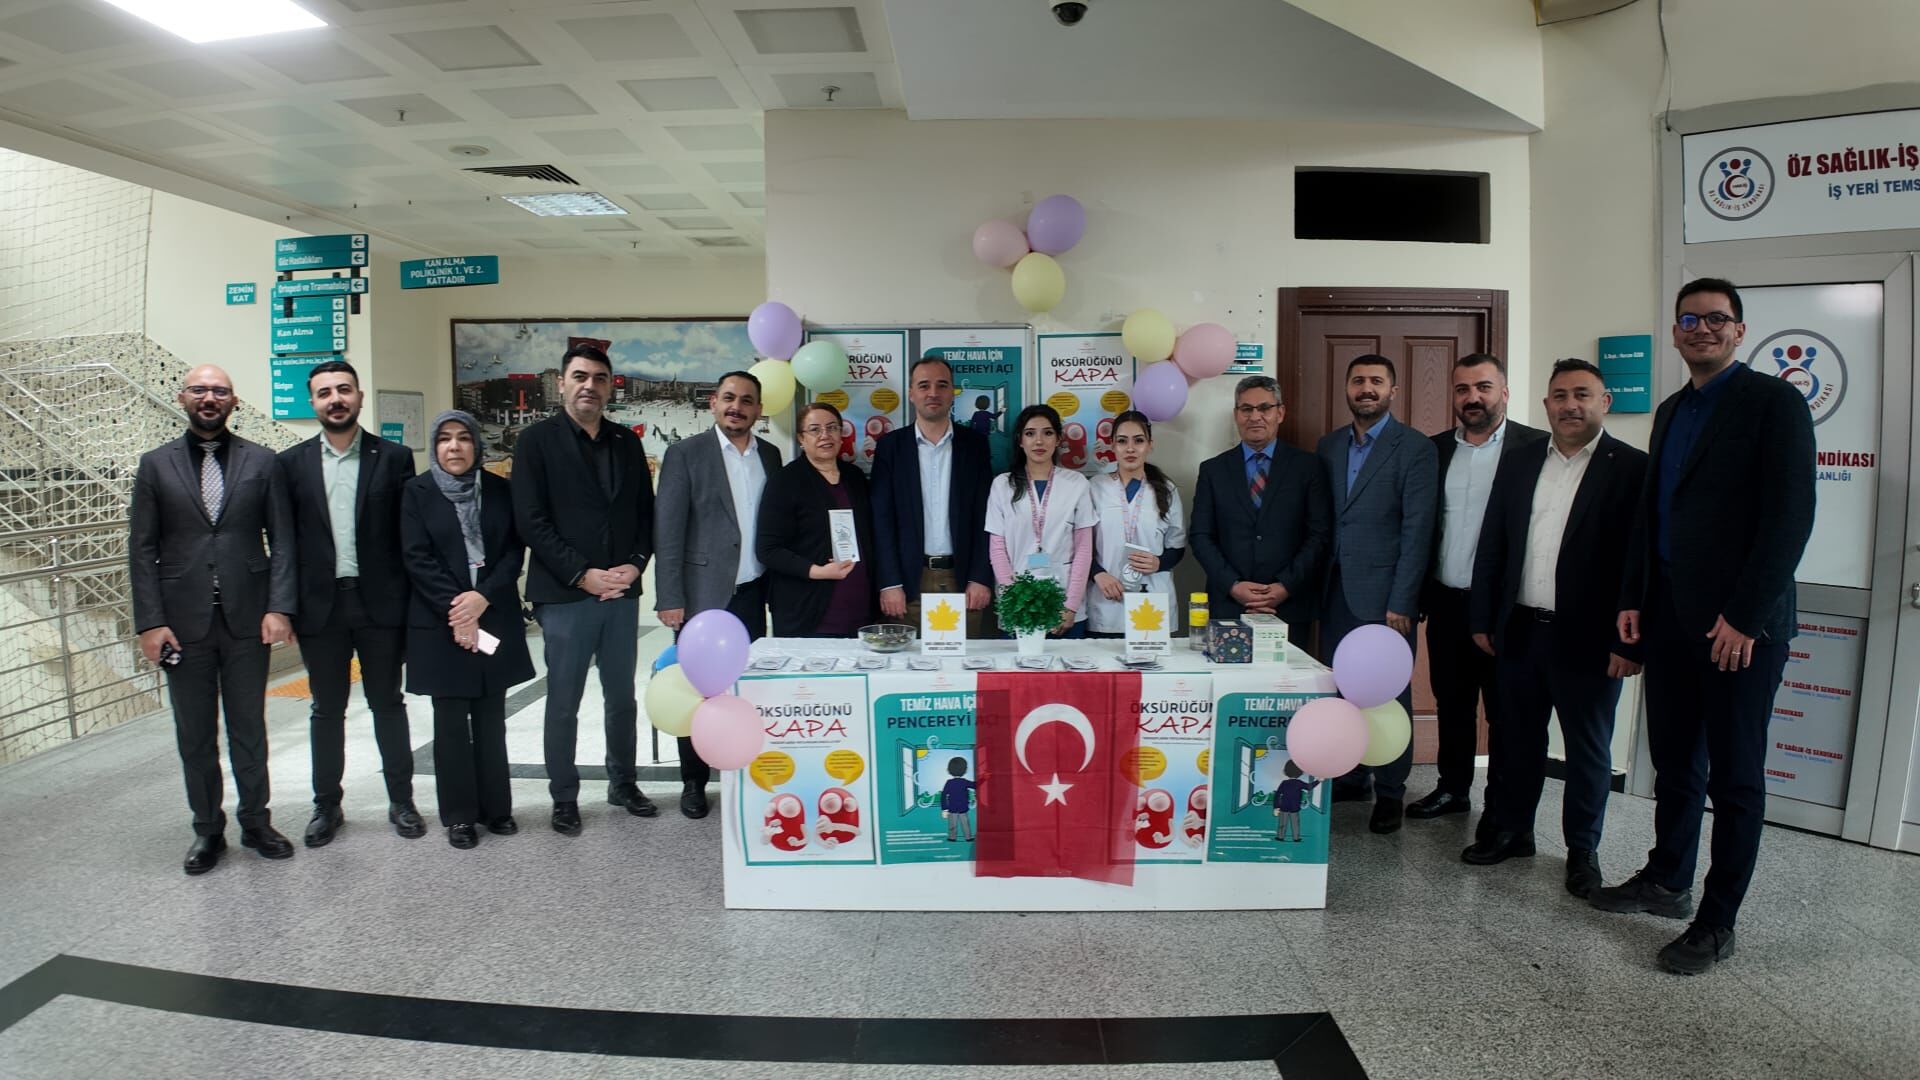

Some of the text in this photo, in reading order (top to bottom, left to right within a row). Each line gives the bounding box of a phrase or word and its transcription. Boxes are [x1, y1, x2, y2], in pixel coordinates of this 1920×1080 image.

[1787, 142, 1920, 178] ÖZ SAĞLIK-İŞ
[1828, 183, 1842, 200] İŞ
[1846, 178, 1879, 196] YERİ
[425, 257, 466, 268] KAN ALMA
[464, 265, 474, 274] VE
[426, 275, 466, 286] KATTADIR
[228, 284, 254, 295] ZEMİN
[232, 294, 249, 303] KAT
[277, 328, 314, 337] Kan Alma
[848, 352, 893, 364] RÜĞÜNÜ
[942, 348, 1004, 363] TEMİZ HAVA İÇİN
[1051, 355, 1123, 367] ÖKSÜRÜĞÜNÜ
[847, 365, 888, 380] APA
[1054, 367, 1119, 383] KAPA
[1810, 383, 1835, 411] NDİKASI
[1817, 450, 1875, 468] NDİKASI
[1817, 469, 1852, 482] ANLIĞI
[899, 695, 932, 712] TEMİZ
[933, 696, 962, 711] HAVA
[1244, 695, 1275, 711] TEMİZ
[887, 711, 971, 729] PENCEREYİ
[1228, 715, 1292, 728] PENCER
